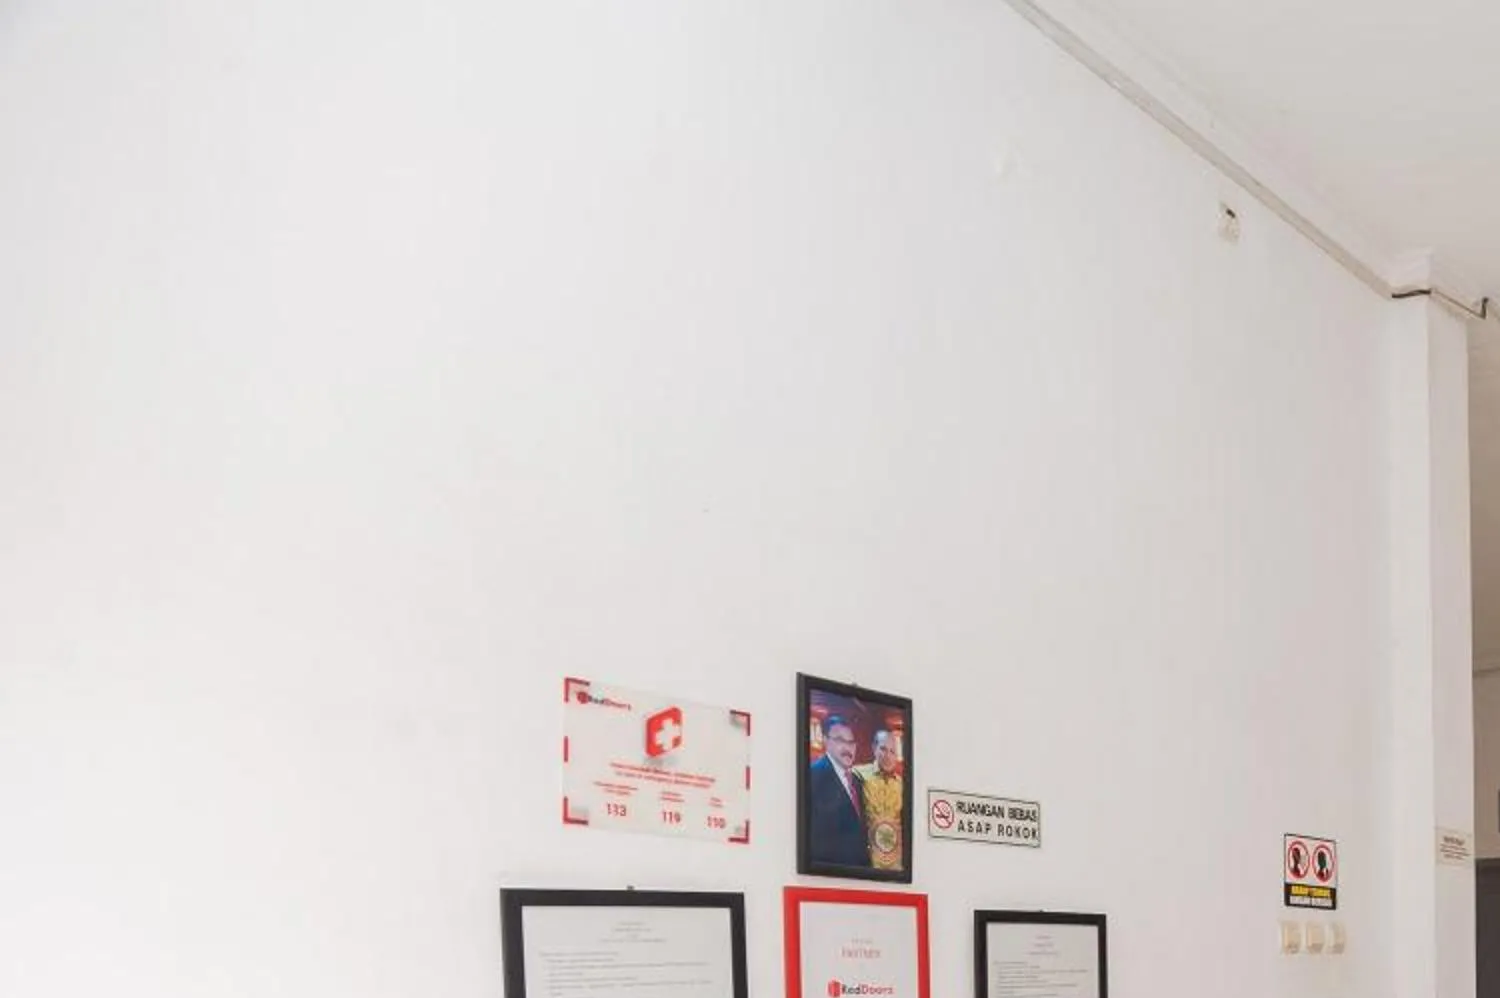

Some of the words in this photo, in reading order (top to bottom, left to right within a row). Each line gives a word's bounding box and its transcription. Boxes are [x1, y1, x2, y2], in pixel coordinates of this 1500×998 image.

[662, 810, 682, 824] 119
[956, 801, 1005, 818] RUANGAN
[1008, 807, 1038, 822] BEBAS
[957, 819, 992, 835] ASAP
[997, 823, 1037, 840] ROKOK
